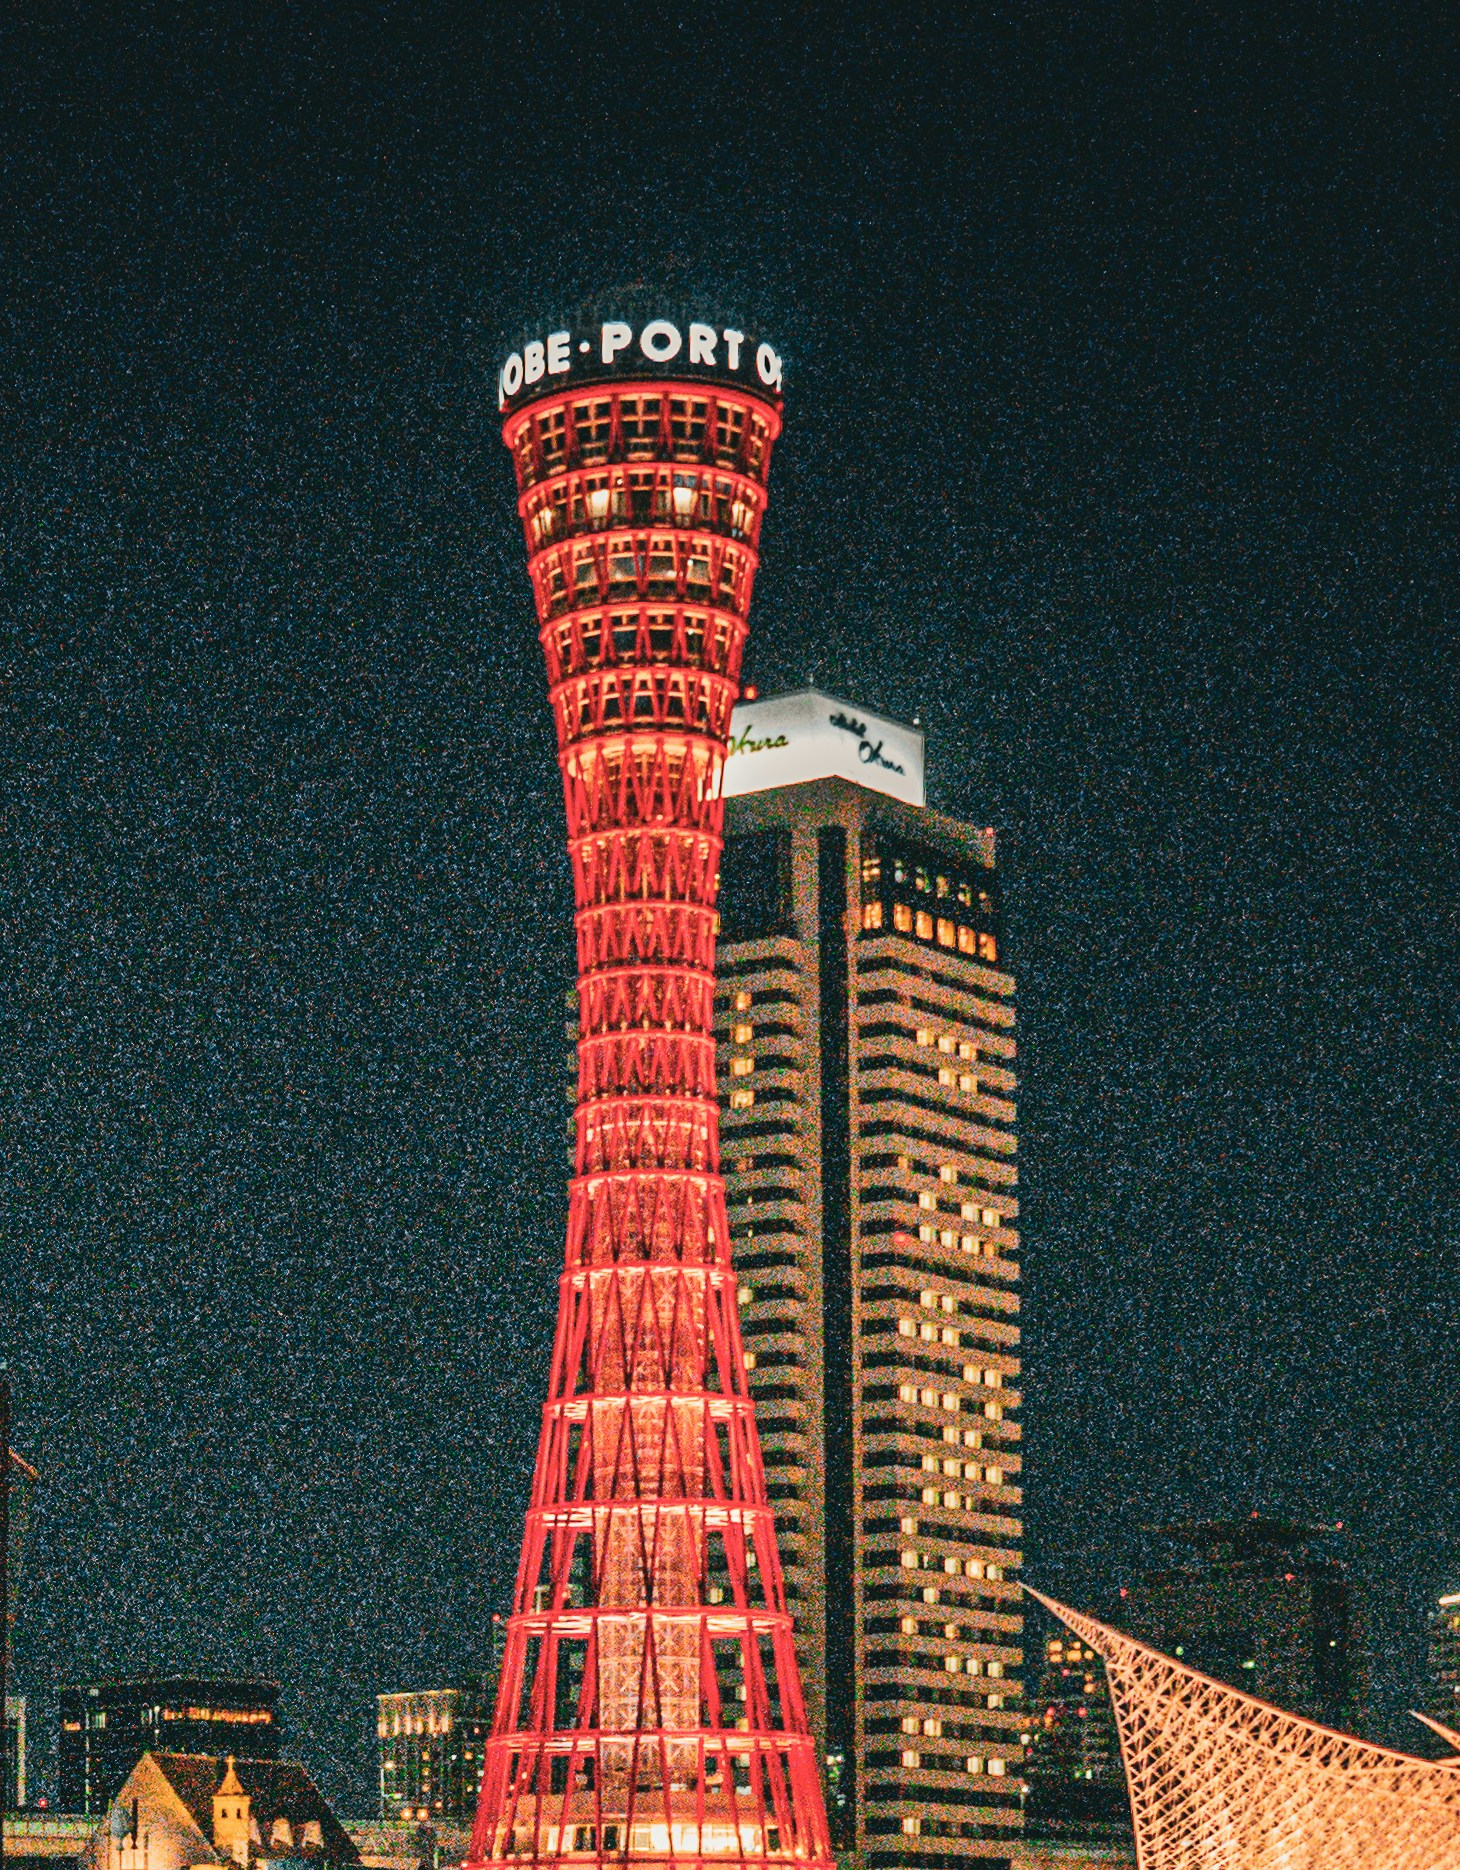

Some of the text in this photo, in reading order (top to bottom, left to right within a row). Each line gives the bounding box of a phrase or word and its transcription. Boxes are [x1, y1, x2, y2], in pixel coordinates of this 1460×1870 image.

[500, 319, 783, 404] OBE PORT O
